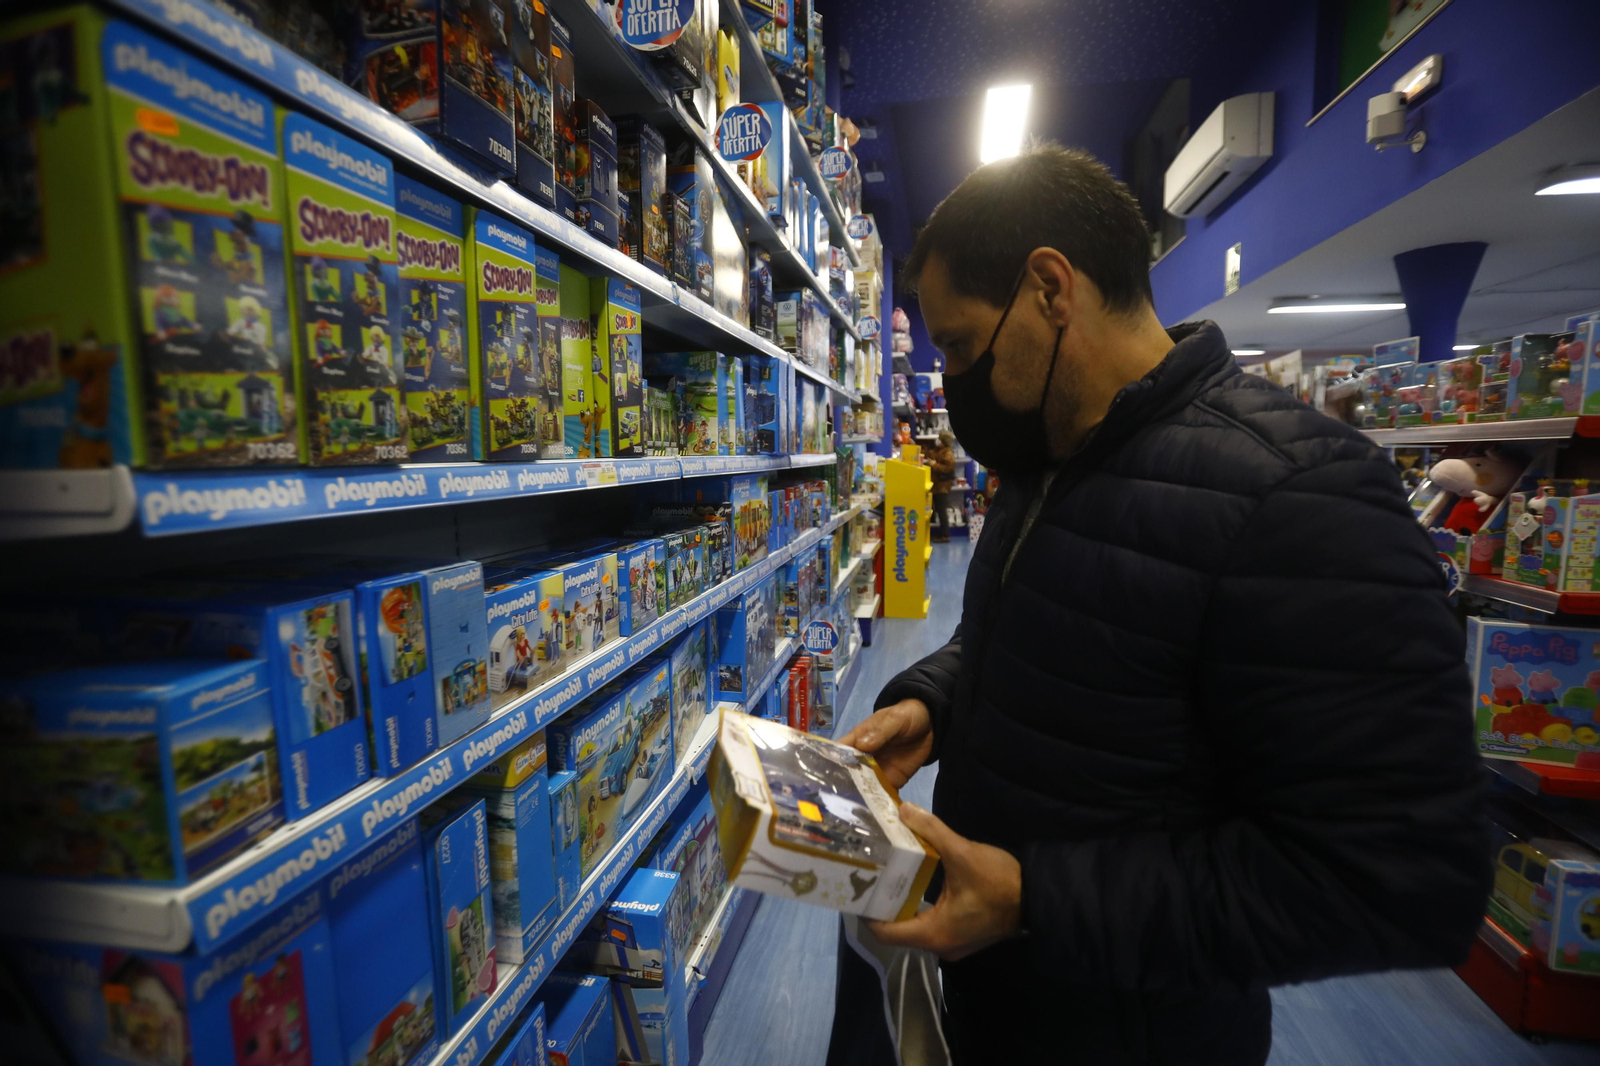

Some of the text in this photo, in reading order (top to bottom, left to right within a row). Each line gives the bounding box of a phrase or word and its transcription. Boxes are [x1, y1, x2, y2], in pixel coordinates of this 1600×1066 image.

[627, 6, 682, 37] OFERTTA
[682, 56, 698, 78] 70625
[112, 43, 265, 127] playmobil
[722, 112, 761, 139] SÚPER
[290, 130, 387, 187] playmobil
[488, 137, 512, 164] 70390
[722, 134, 763, 157] OFERTTA
[821, 148, 846, 168] SÚPER
[822, 162, 847, 178] OFERTTA
[400, 188, 453, 219] playmobil
[540, 181, 553, 199] 70391
[487, 224, 527, 250] playmobil
[483, 260, 534, 297] SCOOBY-DOO!
[614, 289, 637, 306] playmobil
[689, 352, 711, 366] SUPER
[700, 358, 716, 373] SET
[247, 442, 297, 459] 70362
[374, 445, 408, 459] 70362
[445, 443, 468, 455] 70364
[520, 443, 537, 454] 70364
[564, 445, 574, 455] 286
[517, 466, 570, 491] playmobil
[620, 464, 652, 480] playmobil
[654, 460, 680, 478] playmobil
[324, 475, 427, 508] playmobil
[438, 470, 510, 498] playmobil
[145, 479, 305, 524] playmobil
[652, 506, 694, 517] playmobil
[892, 506, 909, 582] playmobil
[432, 568, 481, 594] playmobil
[564, 560, 599, 592] playmobil
[487, 589, 537, 624] playmobil
[511, 607, 538, 630] City Life
[661, 612, 686, 636] playmobil
[807, 624, 832, 641] SÚPER
[628, 629, 658, 658] playmobil
[1492, 632, 1578, 662] Peppa Pig
[587, 651, 625, 688] playmobil
[190, 672, 257, 711] playmobil
[534, 677, 584, 723] playmobil
[575, 700, 621, 745] playmobil
[1480, 731, 1505, 741] Soft
[385, 717, 401, 769] playmobil
[462, 711, 528, 771] playmobil
[290, 750, 310, 811] playmobil
[517, 780, 539, 805] playmobil
[362, 757, 455, 838] playmobil
[637, 804, 665, 850] playmobil
[330, 819, 417, 899] playmobil
[440, 835, 451, 864] 9227
[473, 808, 490, 887] playmobil
[662, 823, 692, 871] playmobil
[205, 822, 348, 940] playmobil
[599, 843, 635, 898] playmobil
[654, 871, 677, 880] 5338
[528, 916, 547, 943] 70436
[551, 891, 595, 959] playmobil
[193, 890, 321, 1003] playmobil
[487, 953, 545, 1041] playmobil
[584, 996, 608, 1042] playmobil
